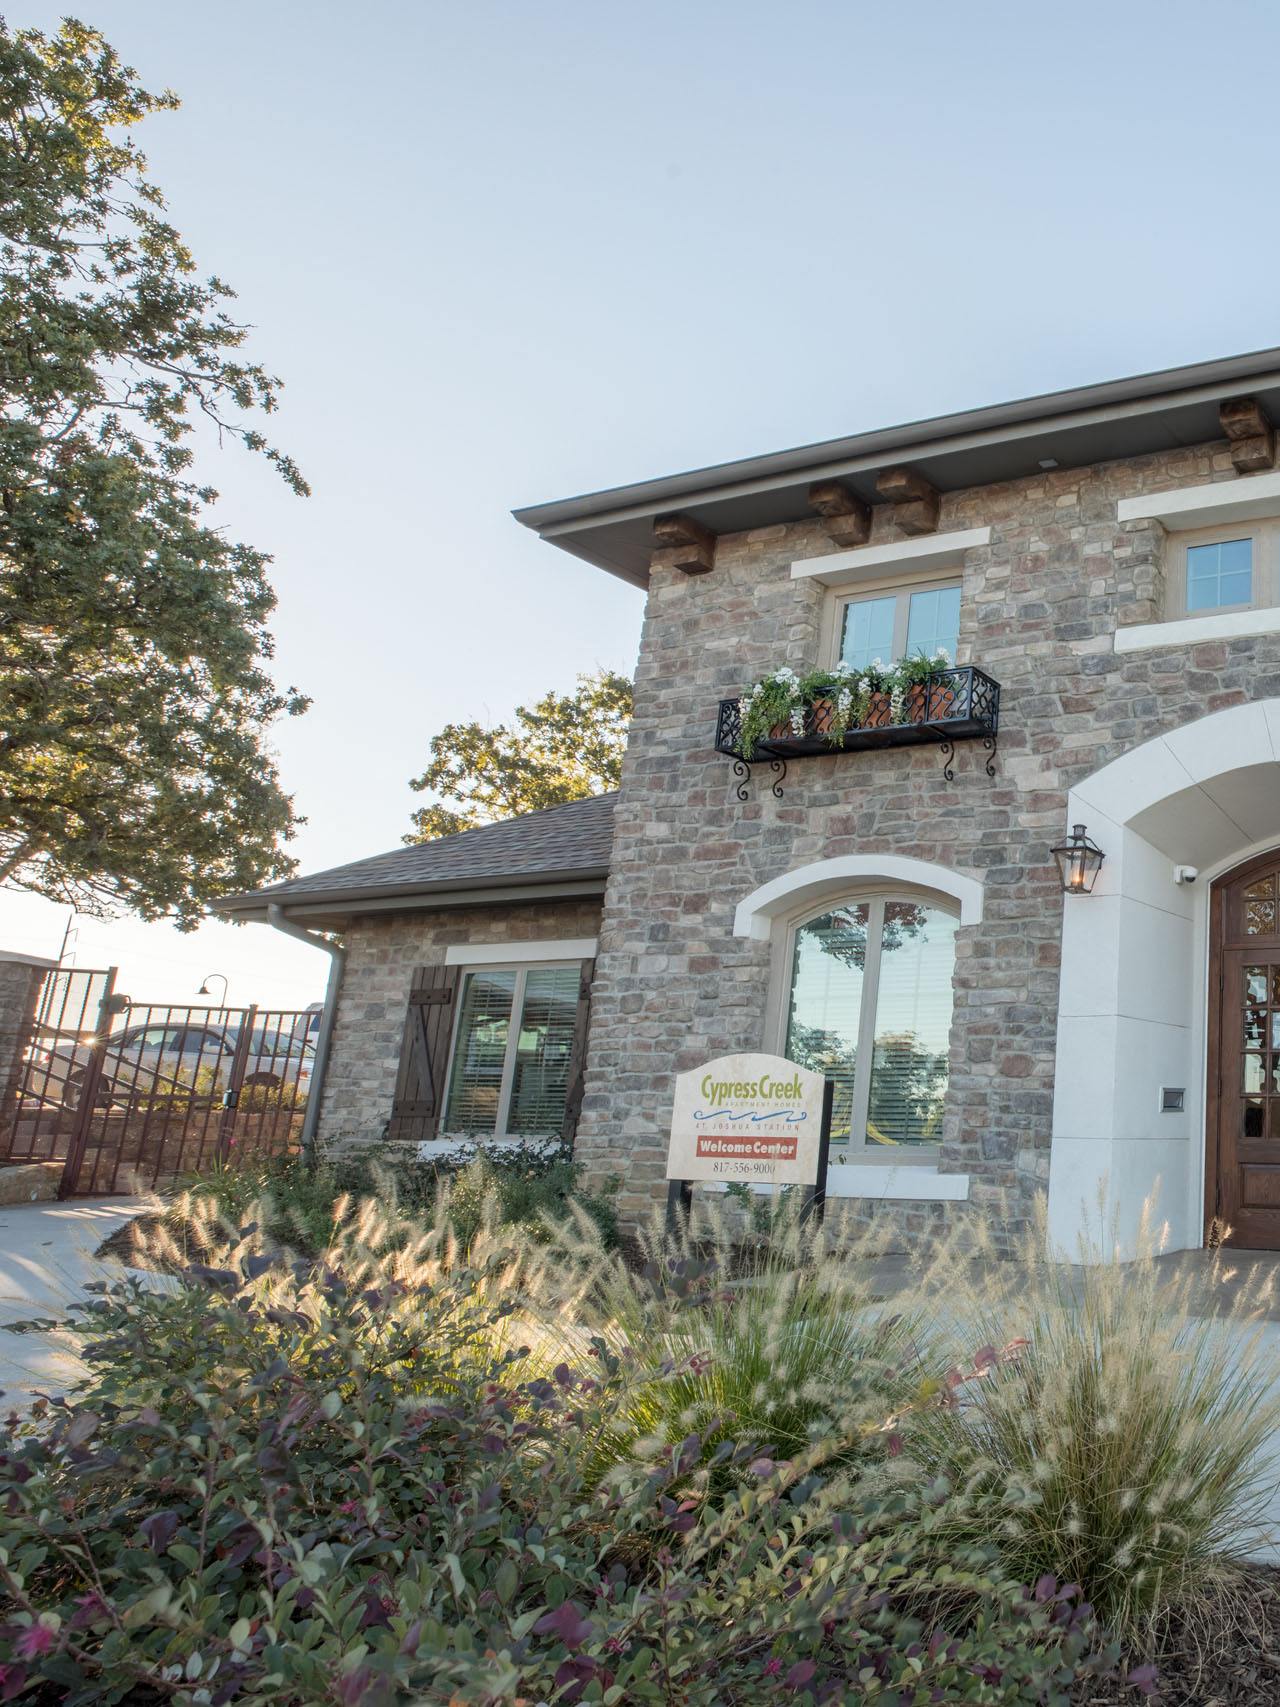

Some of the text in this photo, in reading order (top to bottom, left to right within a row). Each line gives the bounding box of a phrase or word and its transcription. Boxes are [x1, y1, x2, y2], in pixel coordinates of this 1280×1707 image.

[701, 1072, 804, 1106] Cypress Creek
[695, 1122, 800, 1132] AT JOSHUA STATION
[700, 1140, 795, 1155] Welcome Center
[712, 1161, 776, 1174] 817-556-9000
